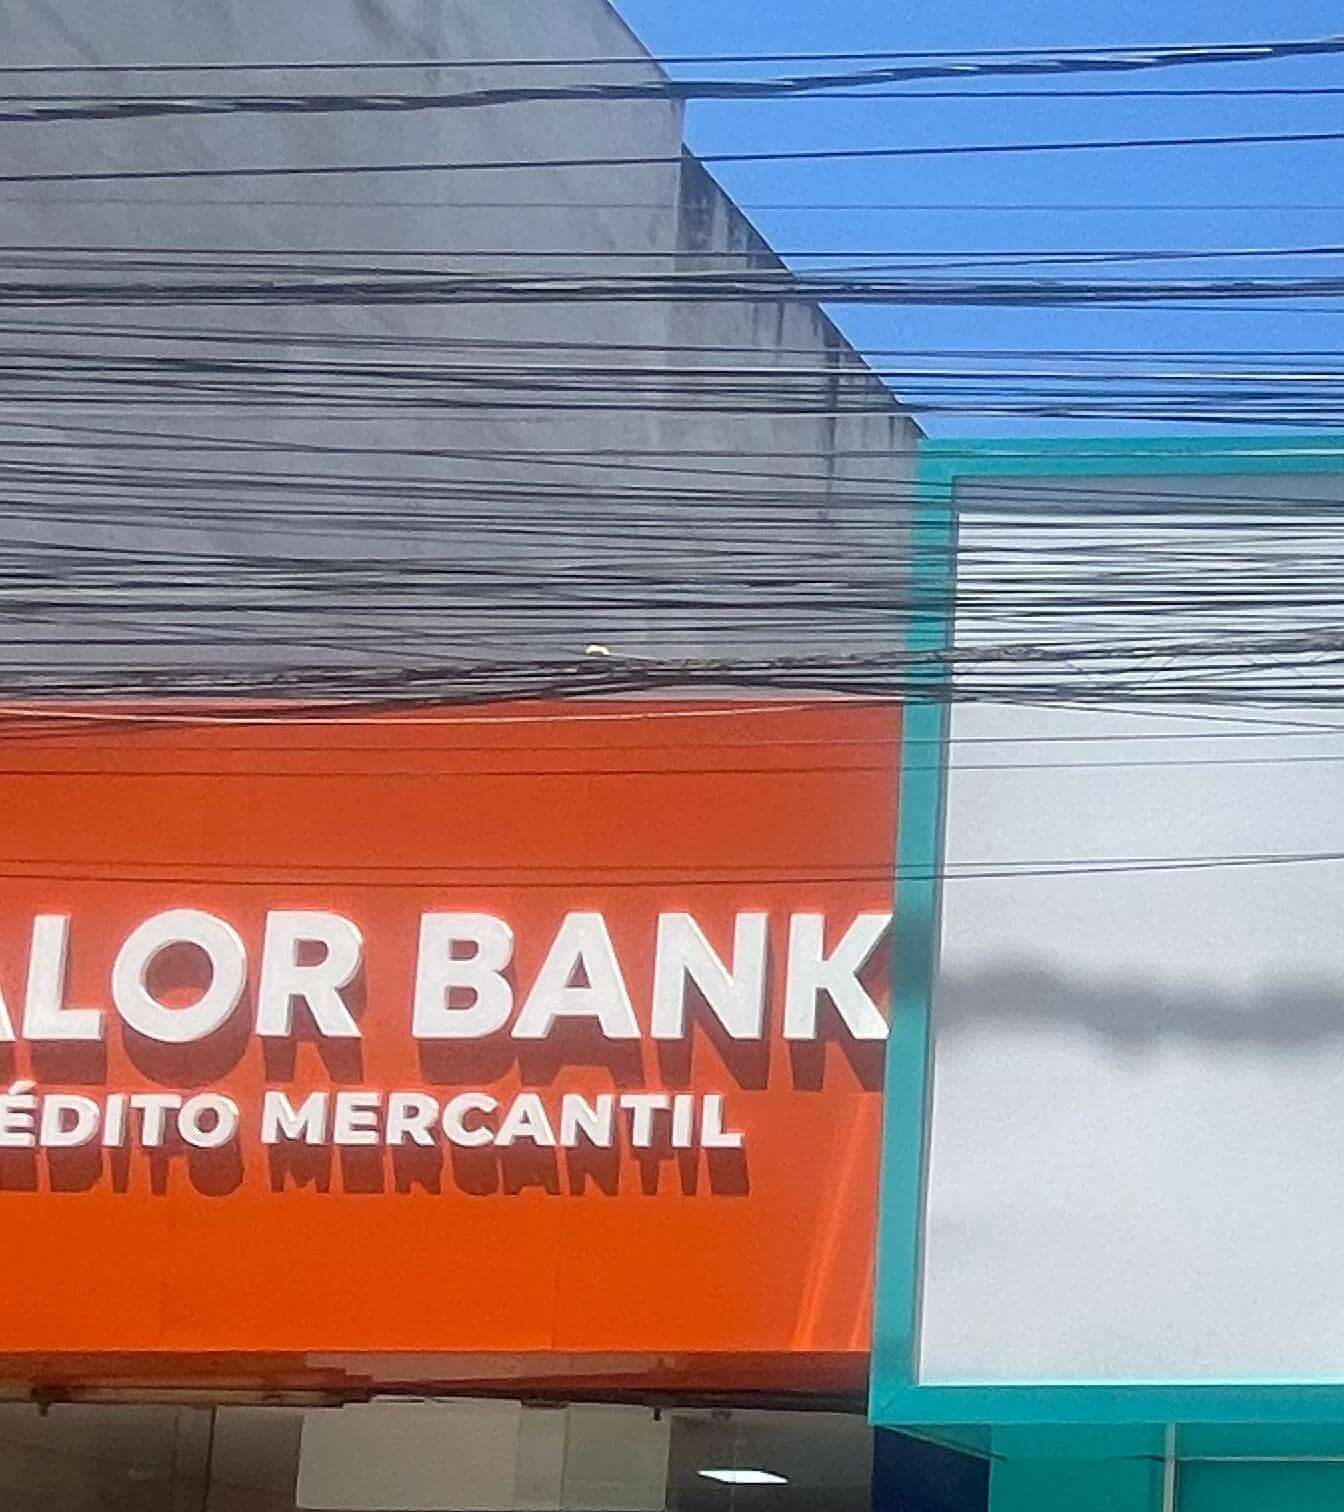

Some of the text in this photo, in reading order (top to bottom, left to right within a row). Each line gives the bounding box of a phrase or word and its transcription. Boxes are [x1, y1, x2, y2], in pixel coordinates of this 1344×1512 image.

[0, 907, 893, 1044] LOR BANK
[260, 1091, 746, 1149] MERCANTIL
